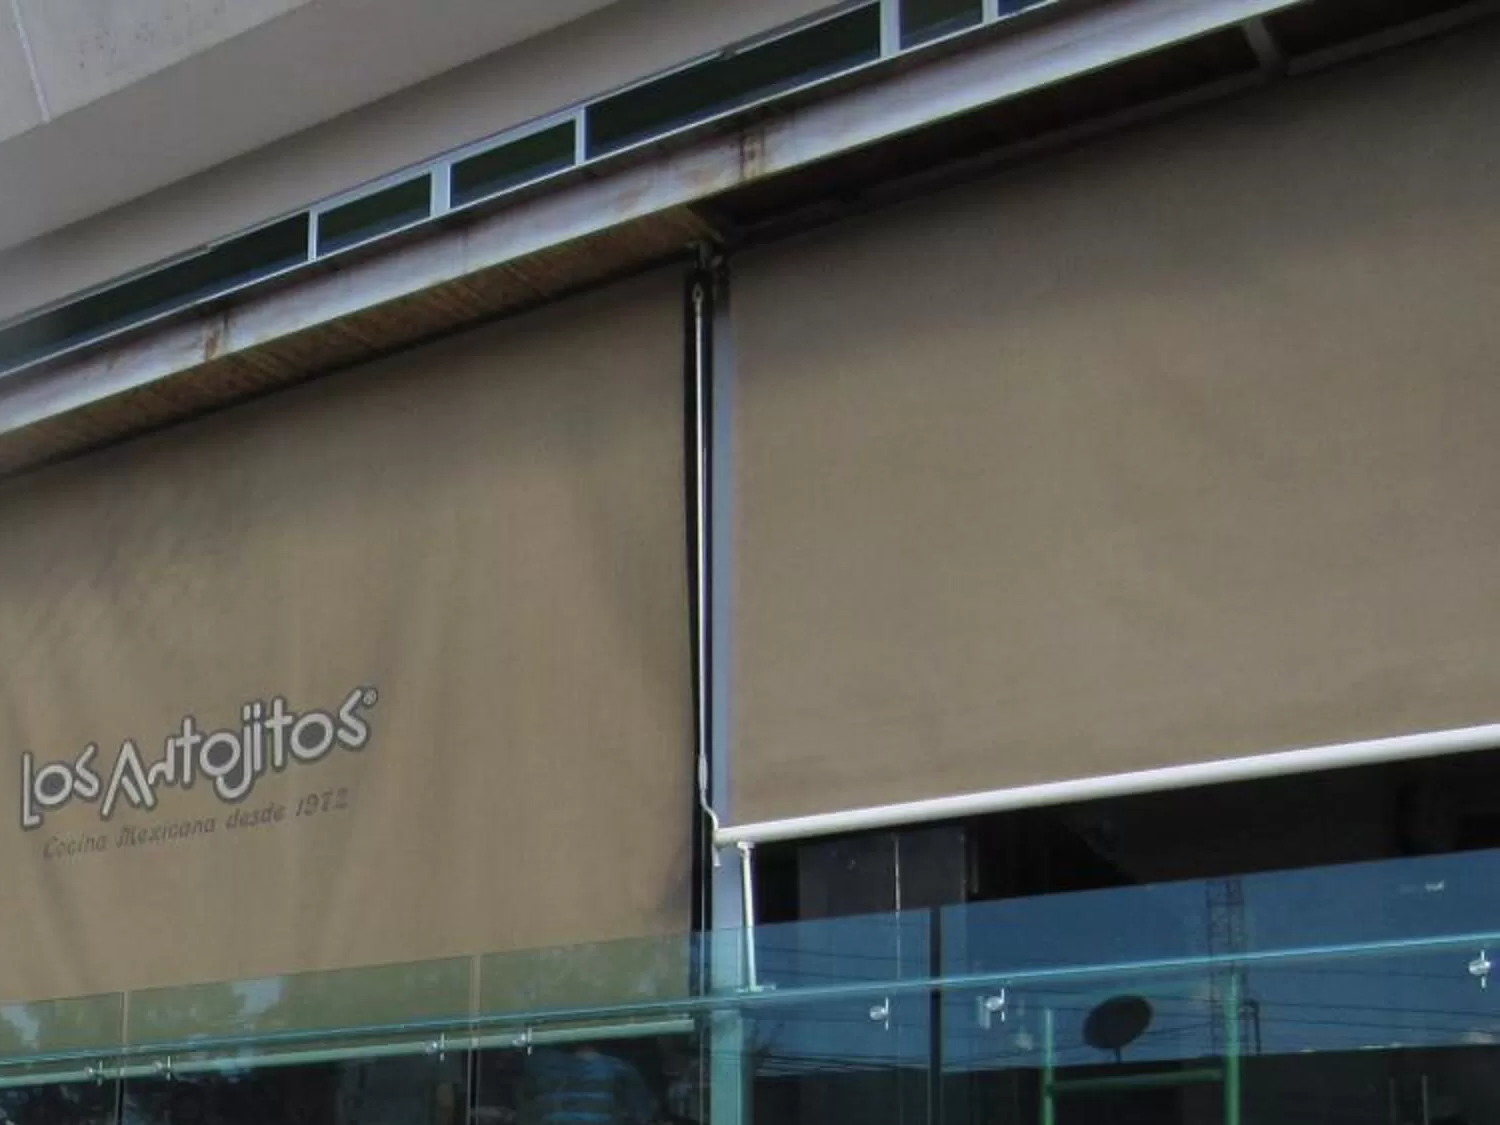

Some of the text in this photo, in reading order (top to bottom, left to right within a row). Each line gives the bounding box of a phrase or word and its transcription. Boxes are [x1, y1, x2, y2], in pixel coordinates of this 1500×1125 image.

[101, 687, 370, 820] Antojitos
[43, 833, 107, 860] Cocina
[115, 815, 218, 849] Mexicana
[225, 802, 288, 831] desde
